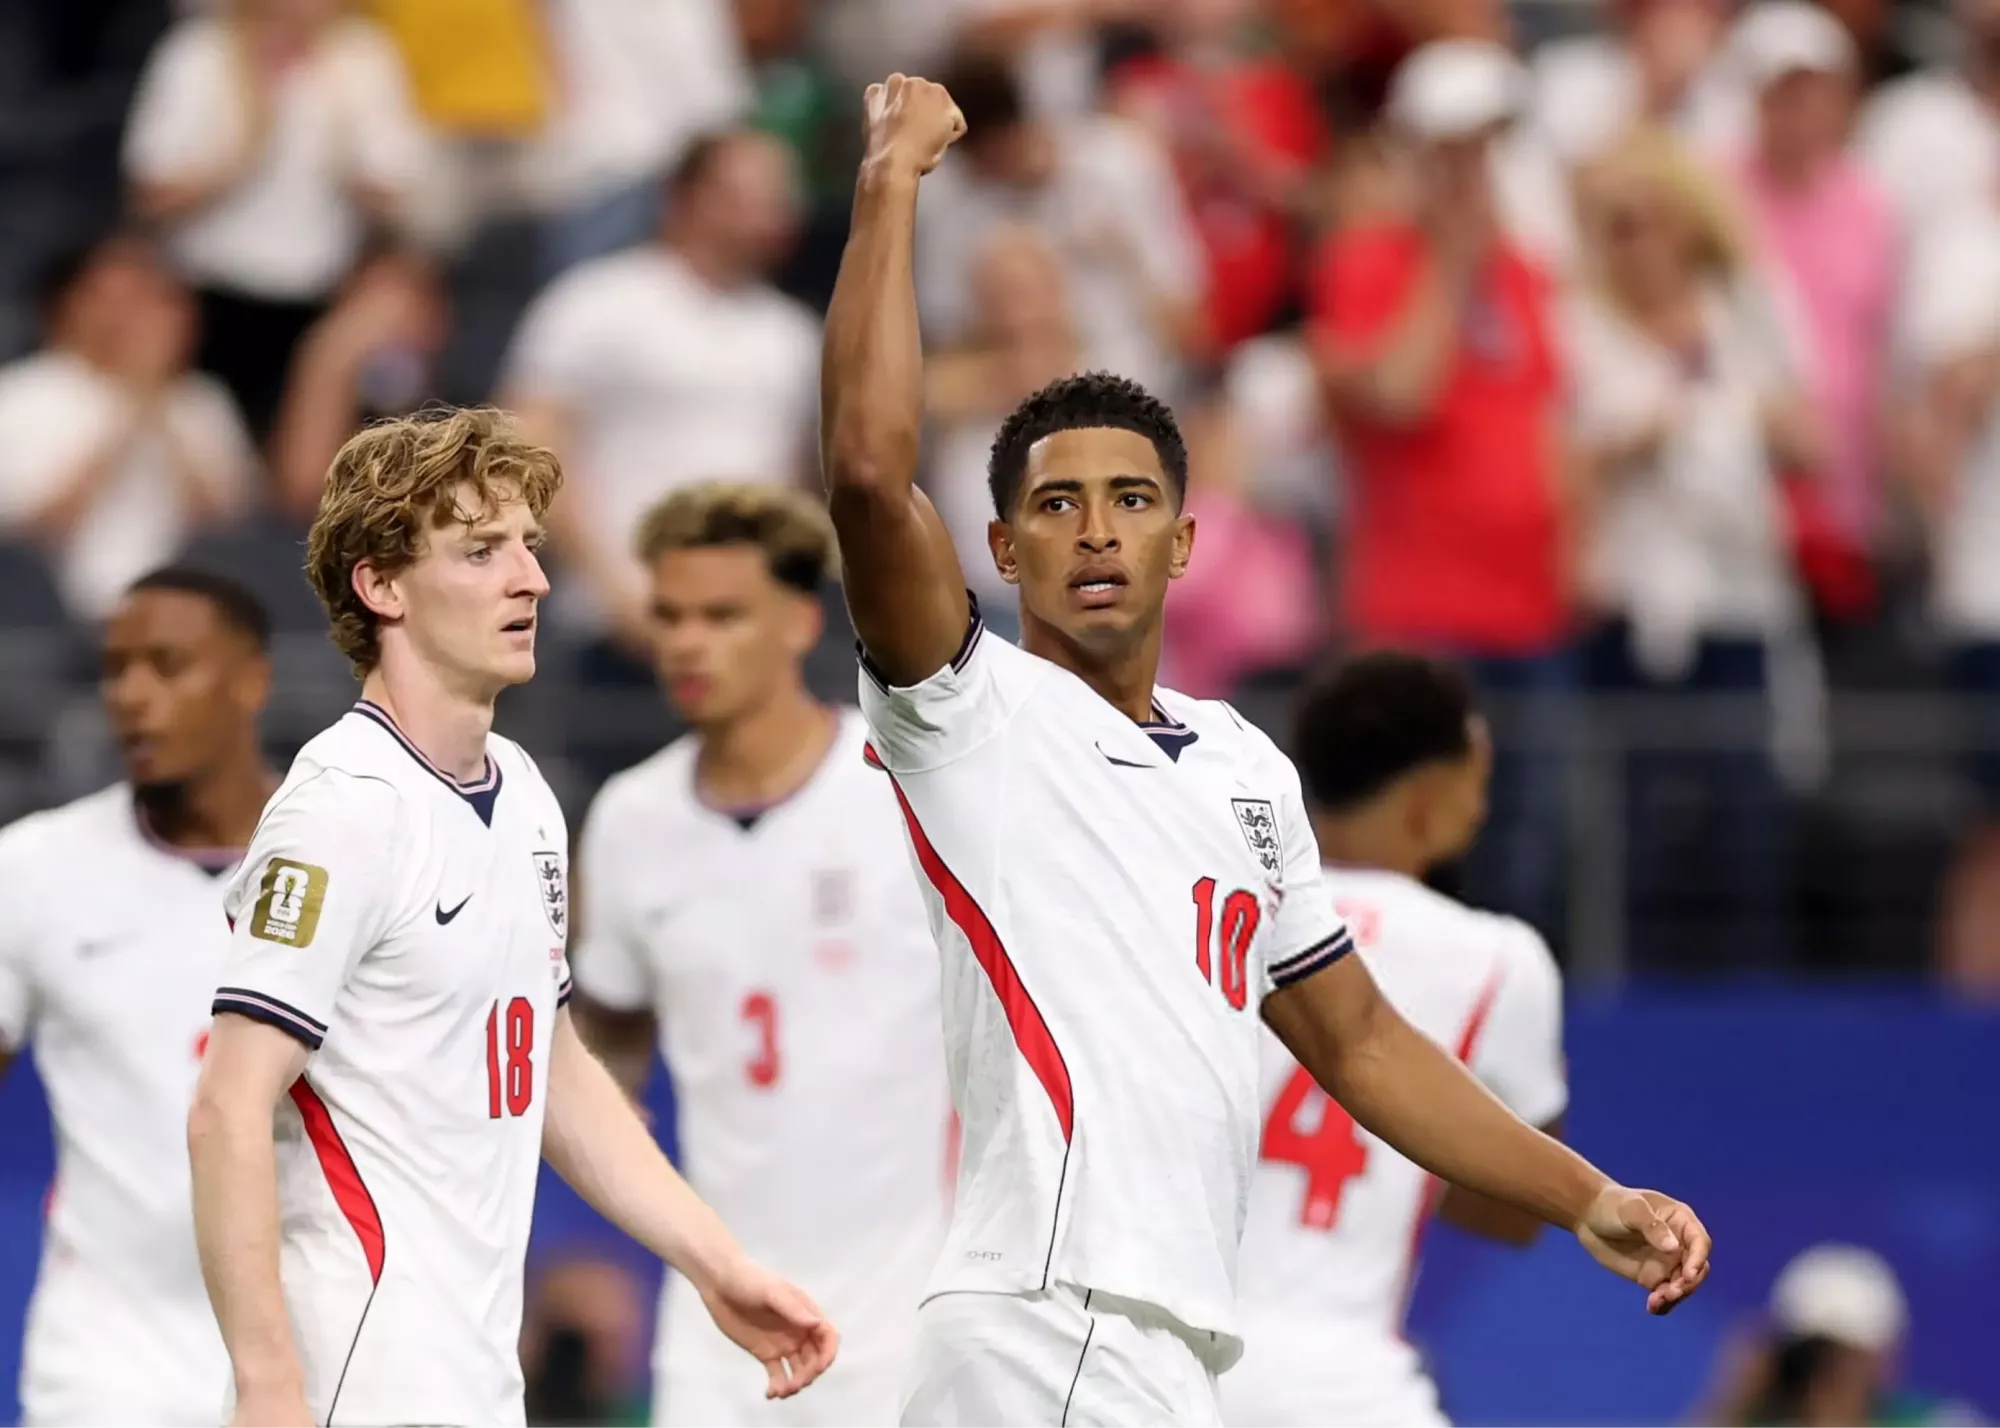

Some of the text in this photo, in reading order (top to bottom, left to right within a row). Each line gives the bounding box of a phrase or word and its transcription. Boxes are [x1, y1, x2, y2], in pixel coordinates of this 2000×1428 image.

[1192, 876, 1261, 1011] 10
[486, 996, 534, 1119] 18
[741, 991, 781, 1088] 3
[1260, 1062, 1368, 1231] 4
